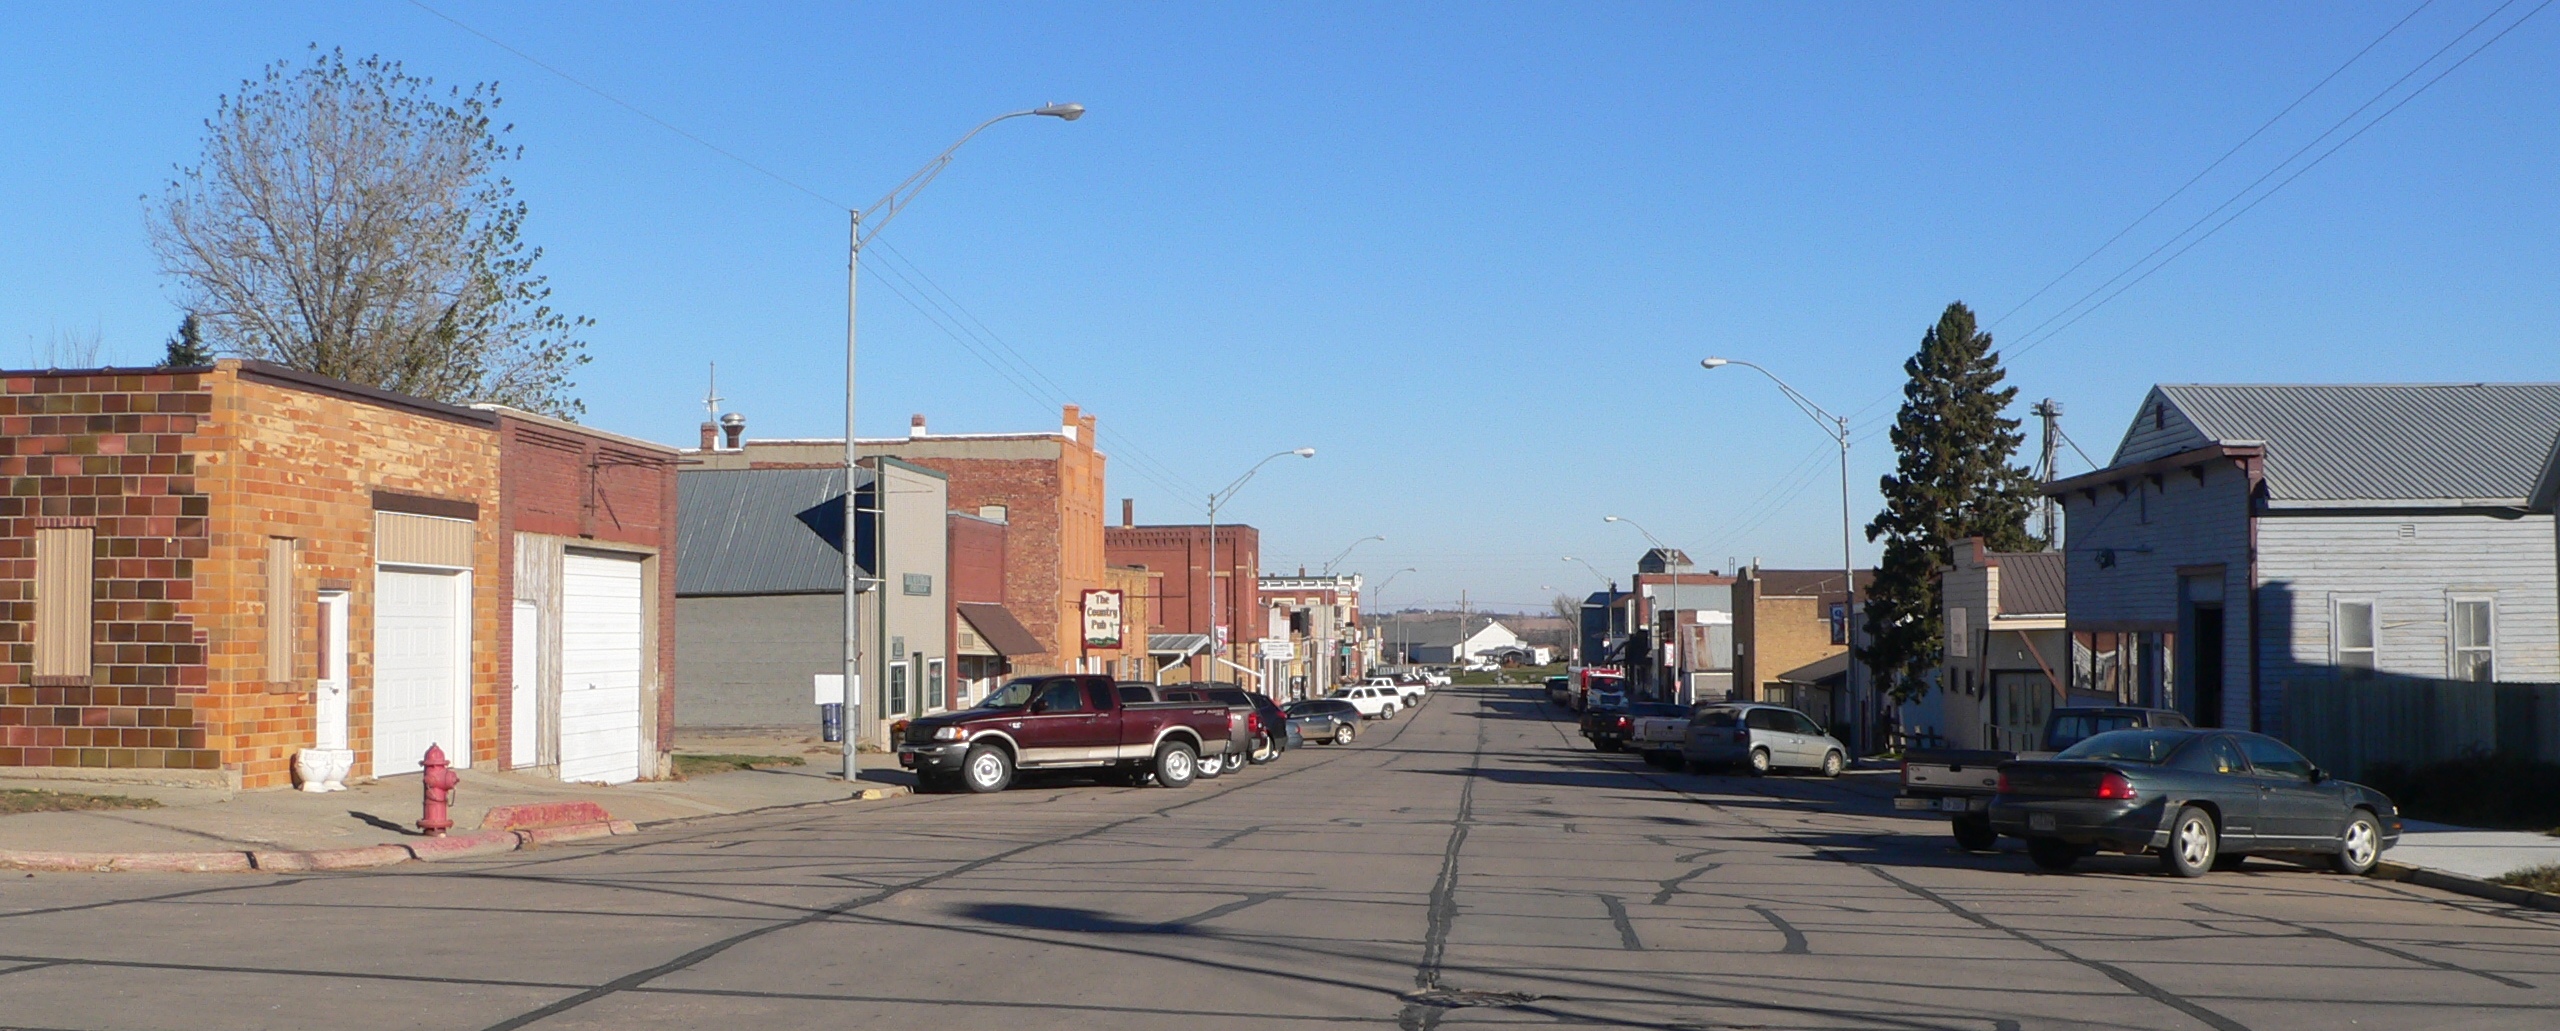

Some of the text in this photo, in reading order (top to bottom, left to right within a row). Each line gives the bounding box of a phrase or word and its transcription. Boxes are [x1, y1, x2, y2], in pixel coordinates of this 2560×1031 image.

[1095, 595, 1110, 604] The
[1087, 607, 1118, 618] Country
[1091, 619, 1107, 629] Pub
